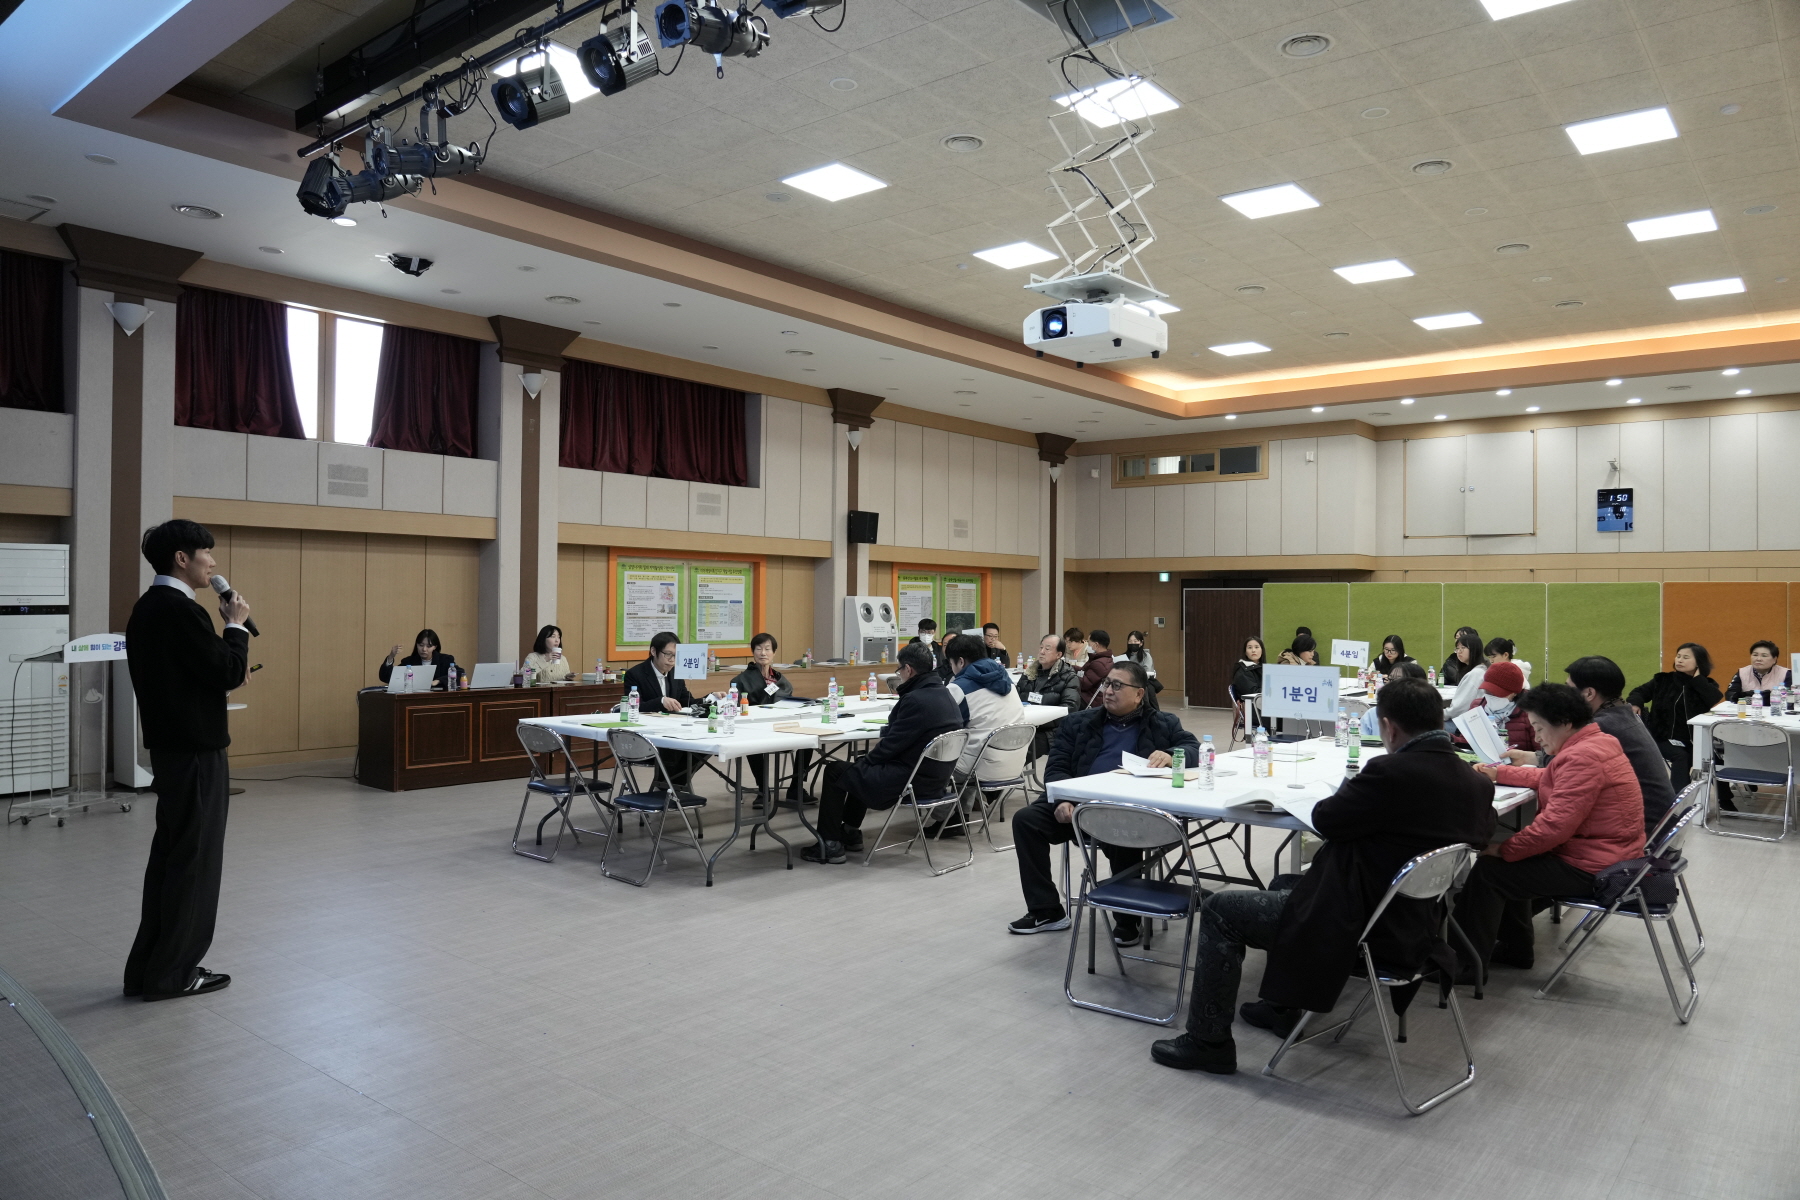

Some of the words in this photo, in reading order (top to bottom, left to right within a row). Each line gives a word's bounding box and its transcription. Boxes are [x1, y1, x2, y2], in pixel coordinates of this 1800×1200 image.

[1609, 494, 1628, 502] 1:50
[71, 644, 77, 652] 내
[1340, 650, 1359, 659] 4분임
[683, 657, 700, 669] 2분임
[1282, 686, 1318, 703] 1분임
